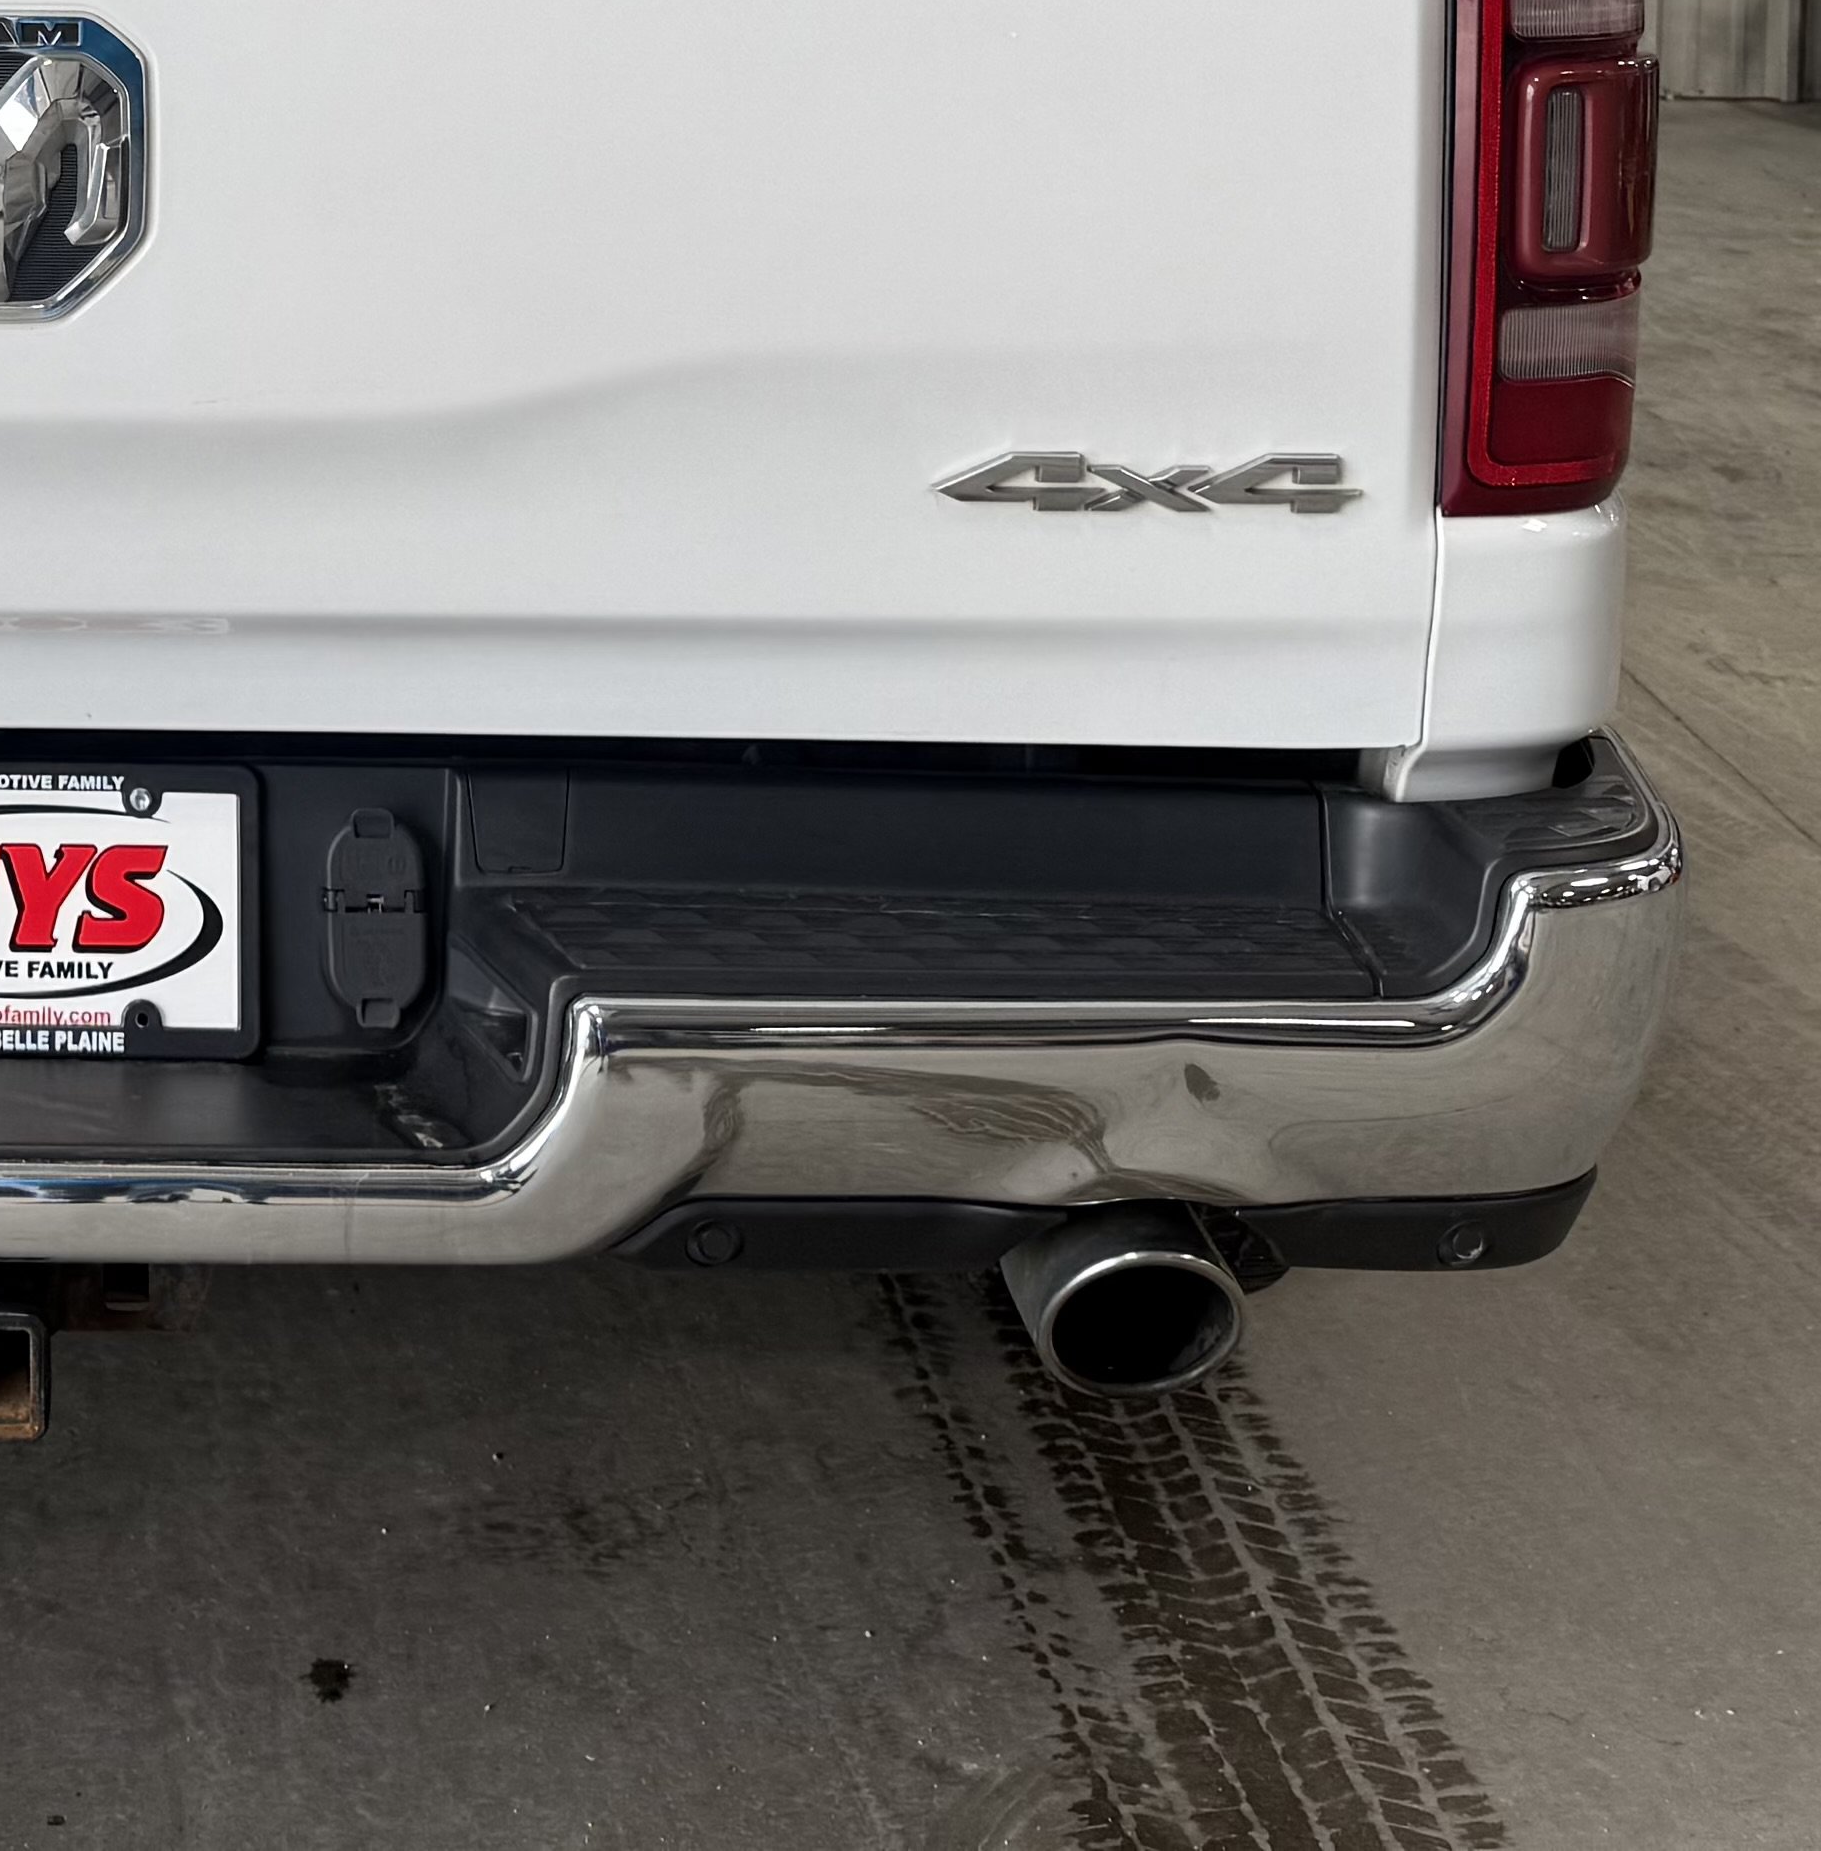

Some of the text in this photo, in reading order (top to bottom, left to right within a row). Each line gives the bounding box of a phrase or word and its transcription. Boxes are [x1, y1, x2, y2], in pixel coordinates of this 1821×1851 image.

[58, 775, 125, 791] FAMILY
[27, 961, 113, 979] FAMILY
[55, 1032, 125, 1053] PLAINE
